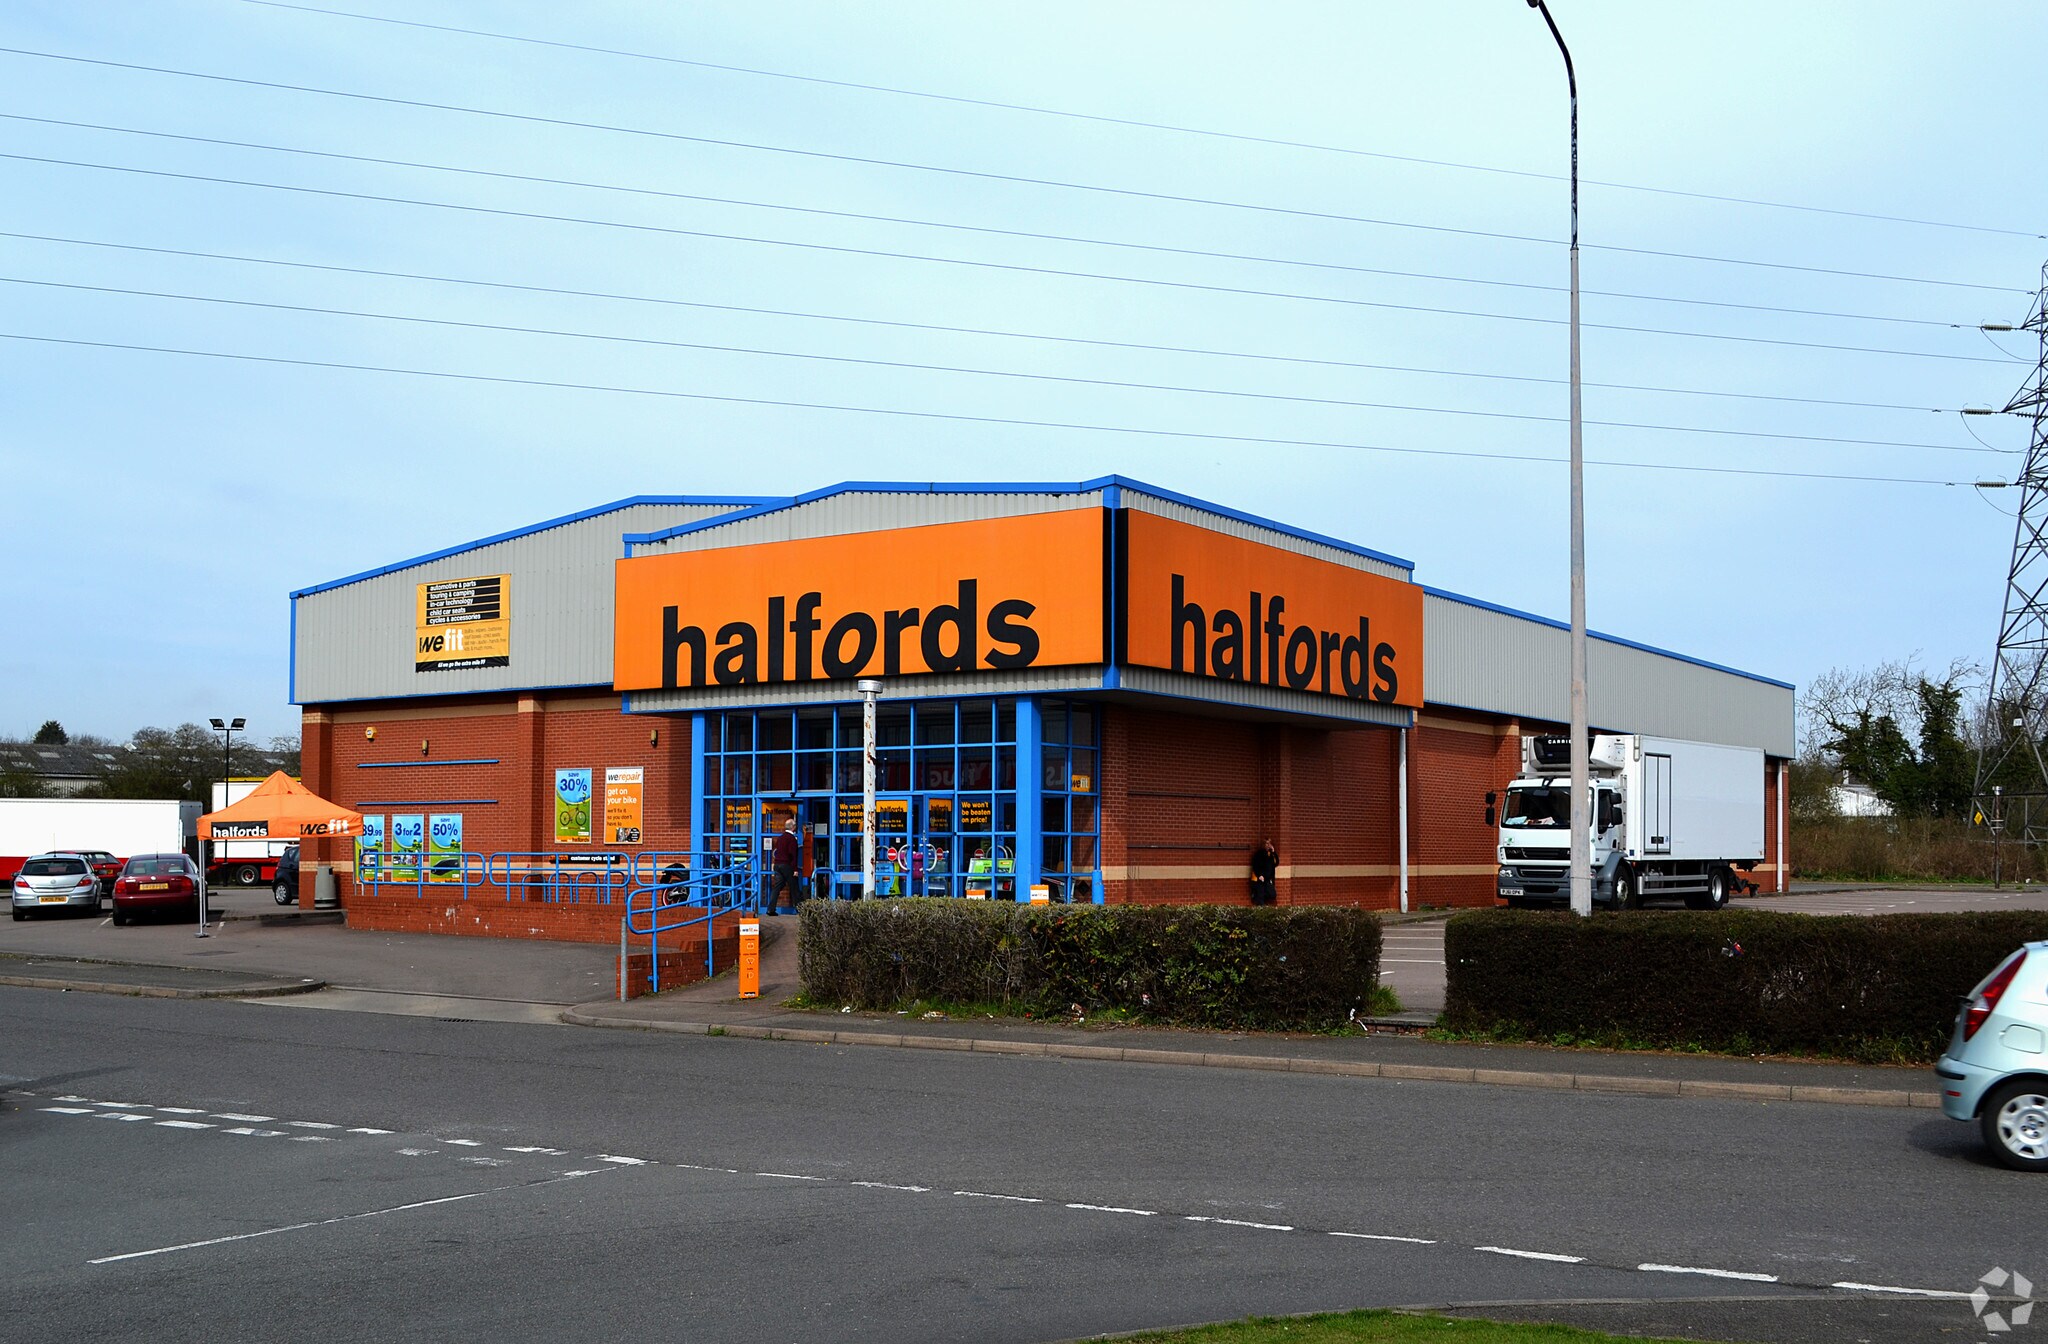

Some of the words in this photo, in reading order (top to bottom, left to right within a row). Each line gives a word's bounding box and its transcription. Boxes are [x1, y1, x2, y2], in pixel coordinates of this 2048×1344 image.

[453, 590, 475, 598] camping
[445, 598, 473, 606] technology
[661, 578, 1040, 688] halfords
[1171, 573, 1398, 704] halfords
[560, 778, 588, 792] 30%
[608, 788, 618, 796] get
[608, 797, 622, 805] your
[970, 816, 988, 824] price!
[213, 826, 268, 837] halfords
[395, 823, 402, 836] 3
[403, 828, 412, 836] for
[413, 823, 421, 835] 2
[433, 823, 458, 836] 50%
